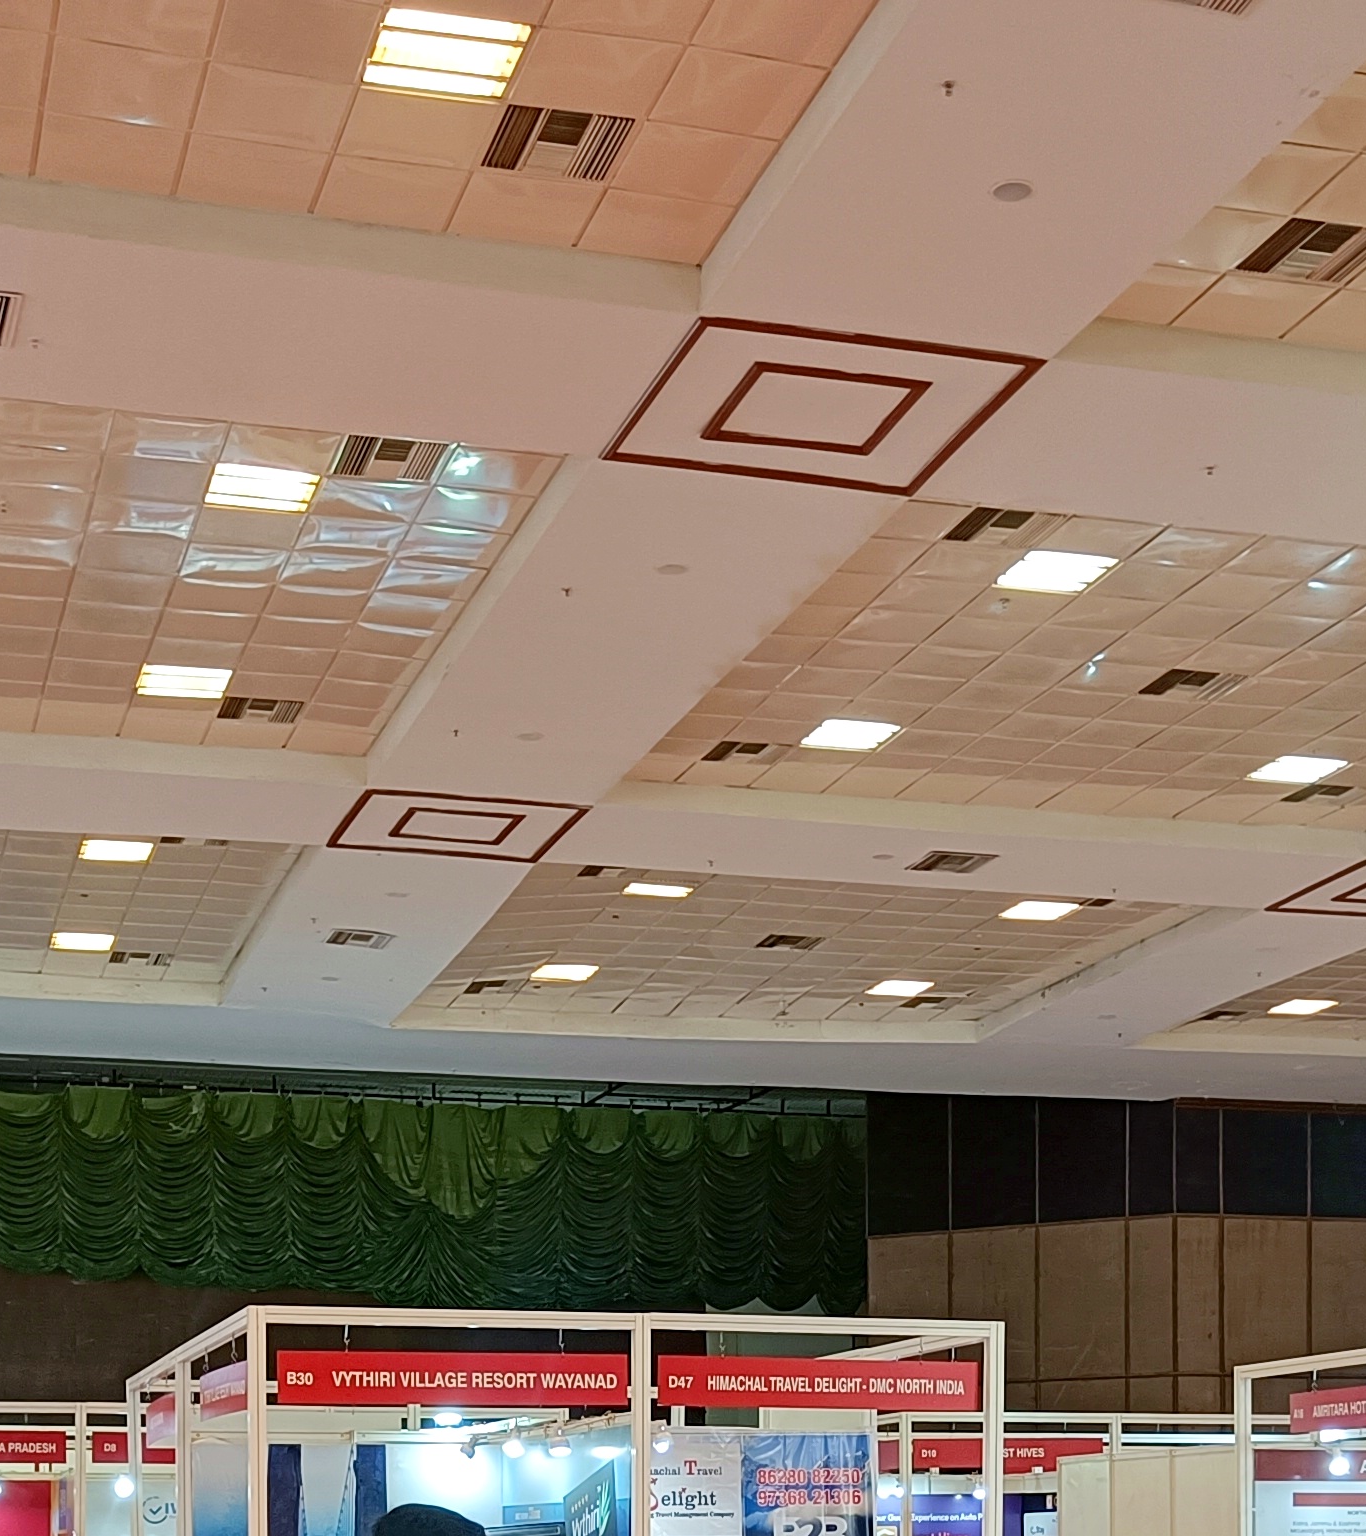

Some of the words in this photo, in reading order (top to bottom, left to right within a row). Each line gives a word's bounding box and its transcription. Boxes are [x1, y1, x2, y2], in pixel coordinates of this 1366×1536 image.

[286, 1371, 314, 1386] B30
[332, 1371, 397, 1388] VYTHIRI
[400, 1371, 468, 1388] VILLAGE
[471, 1372, 537, 1389] RESORT
[540, 1373, 618, 1390] WAYANAD
[668, 1375, 694, 1389] D47
[707, 1375, 769, 1392] HIMACHAL
[769, 1376, 813, 1393] TRAVEL
[869, 1379, 895, 1394] DMC
[896, 1380, 934, 1395] NORTH
[936, 1380, 965, 1396] INDIA
[1293, 1408, 1304, 1419] A16
[1312, 1402, 1349, 1418] AMRITARA
[7, 1442, 57, 1454] PRADESH
[921, 1449, 937, 1458] D10
[1016, 1447, 1045, 1458] HIVES
[683, 1460, 723, 1476] Travel
[757, 1467, 808, 1486] 86280
[810, 1467, 862, 1486] 82250
[811, 1488, 863, 1507] 21306
